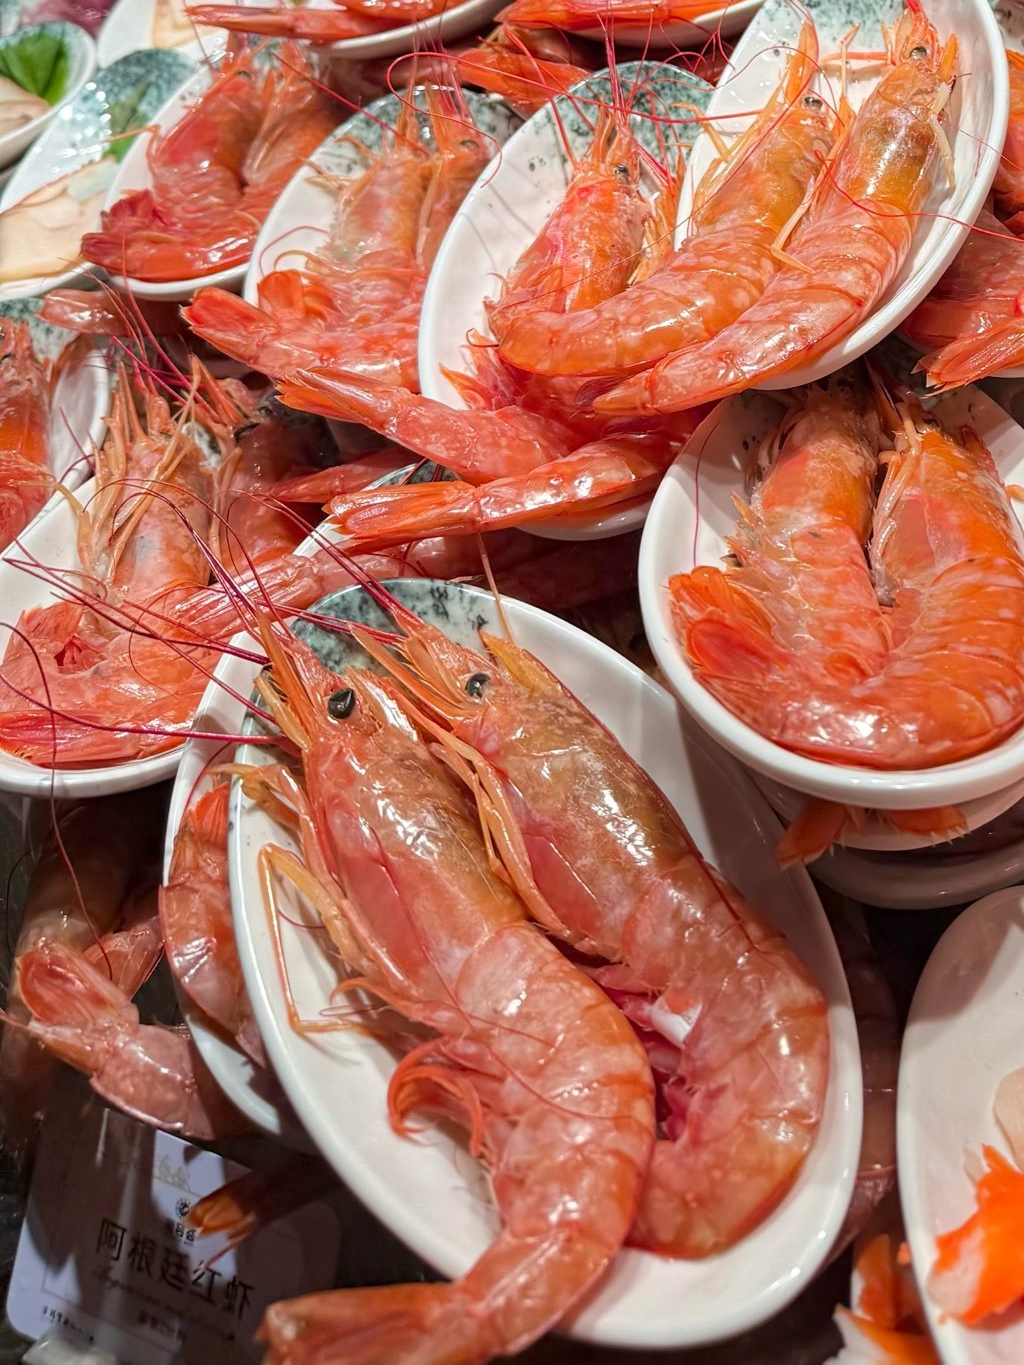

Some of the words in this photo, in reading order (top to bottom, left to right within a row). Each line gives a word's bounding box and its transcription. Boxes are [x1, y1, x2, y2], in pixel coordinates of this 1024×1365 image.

[96, 1217, 255, 1320] 阿根廷红虾
